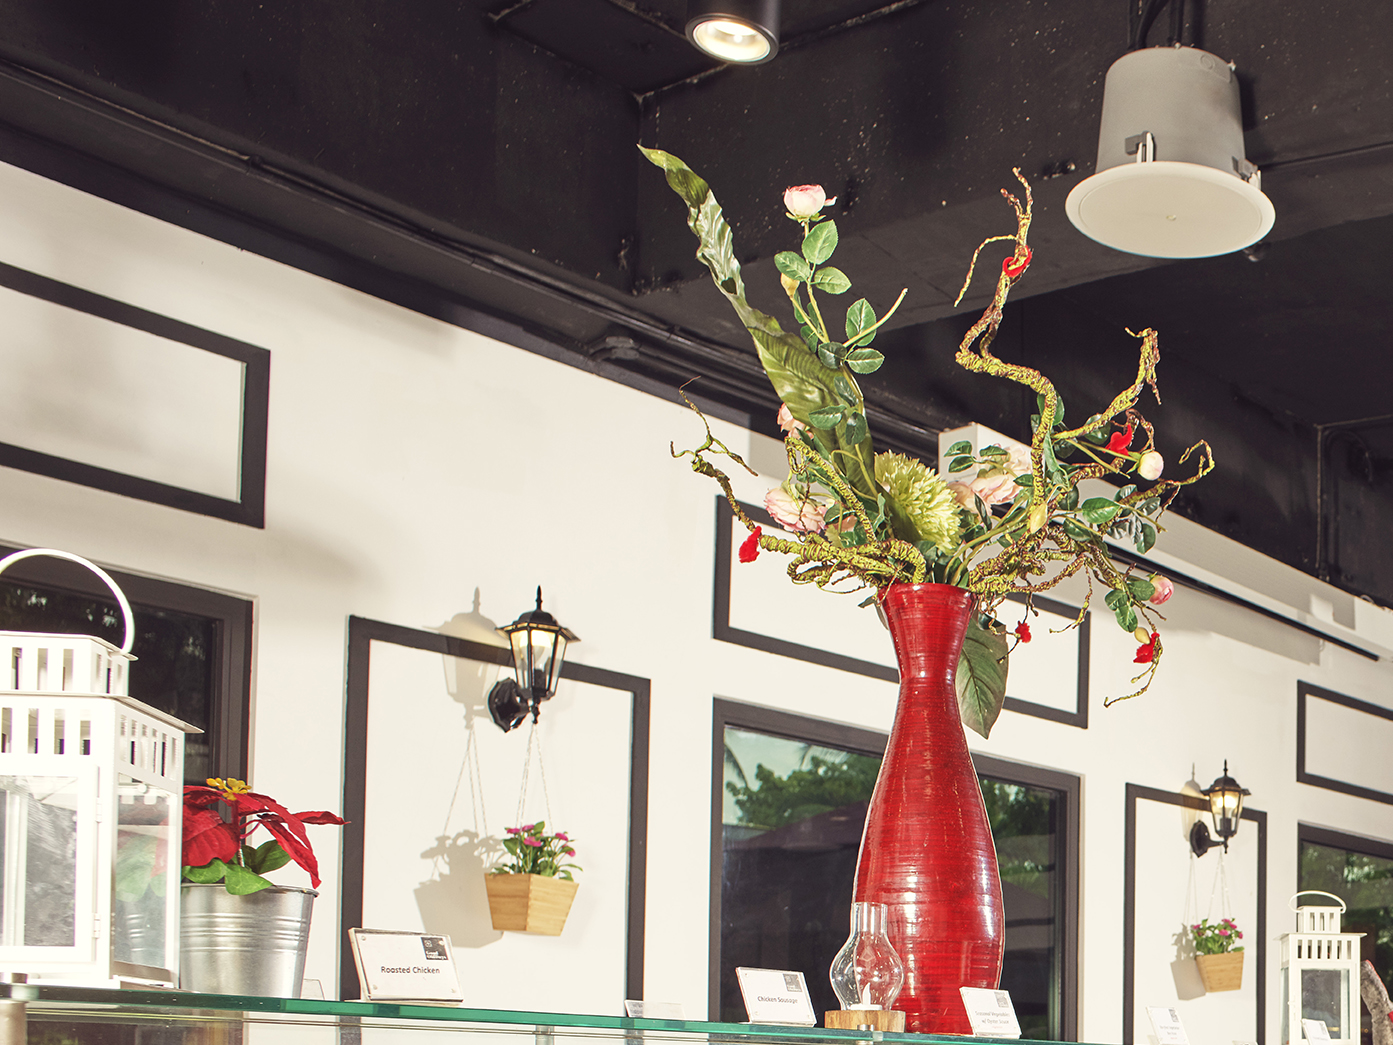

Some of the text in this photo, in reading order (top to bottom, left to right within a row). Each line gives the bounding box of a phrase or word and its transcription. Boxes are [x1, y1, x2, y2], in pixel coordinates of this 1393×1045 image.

[381, 966, 441, 974] Roasted Chicken
[757, 995, 798, 1005] Chicken Sausage
